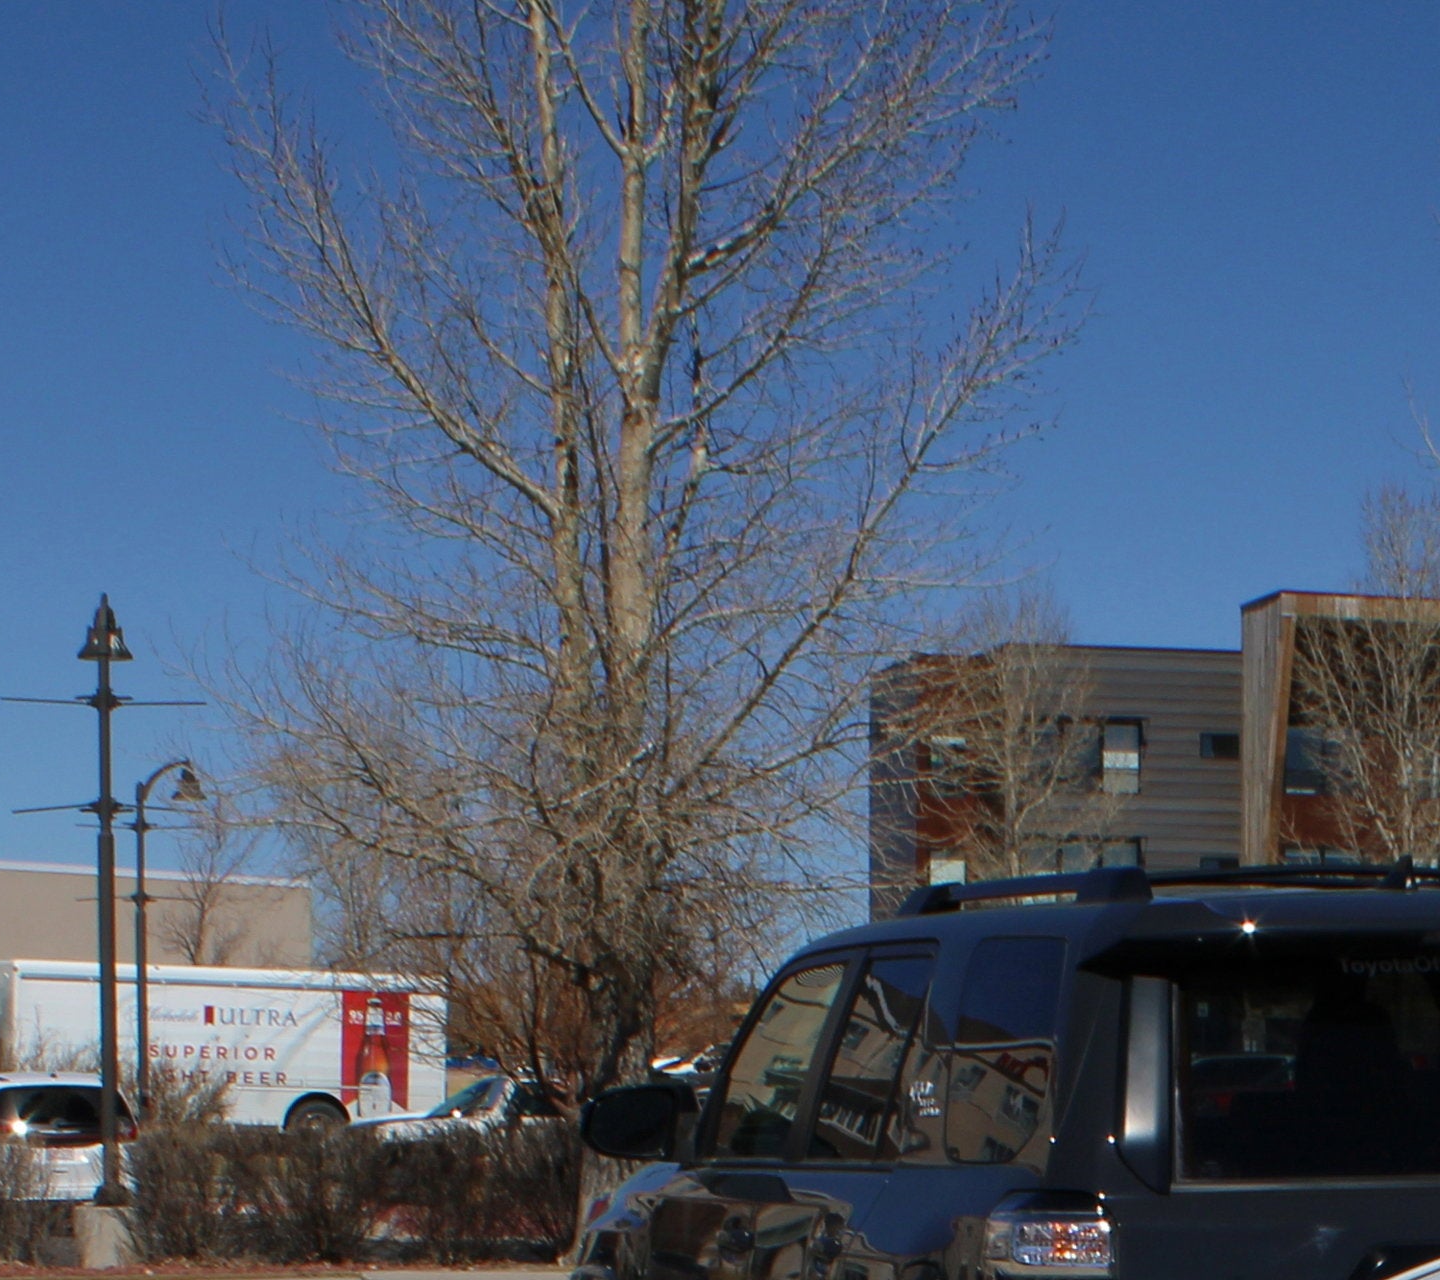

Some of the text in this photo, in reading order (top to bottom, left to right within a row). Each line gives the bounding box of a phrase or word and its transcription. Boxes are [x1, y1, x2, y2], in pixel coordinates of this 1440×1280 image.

[218, 1007, 298, 1027] ULTRA
[148, 1044, 277, 1061] SUPERIOR
[226, 1070, 287, 1086] BEER
